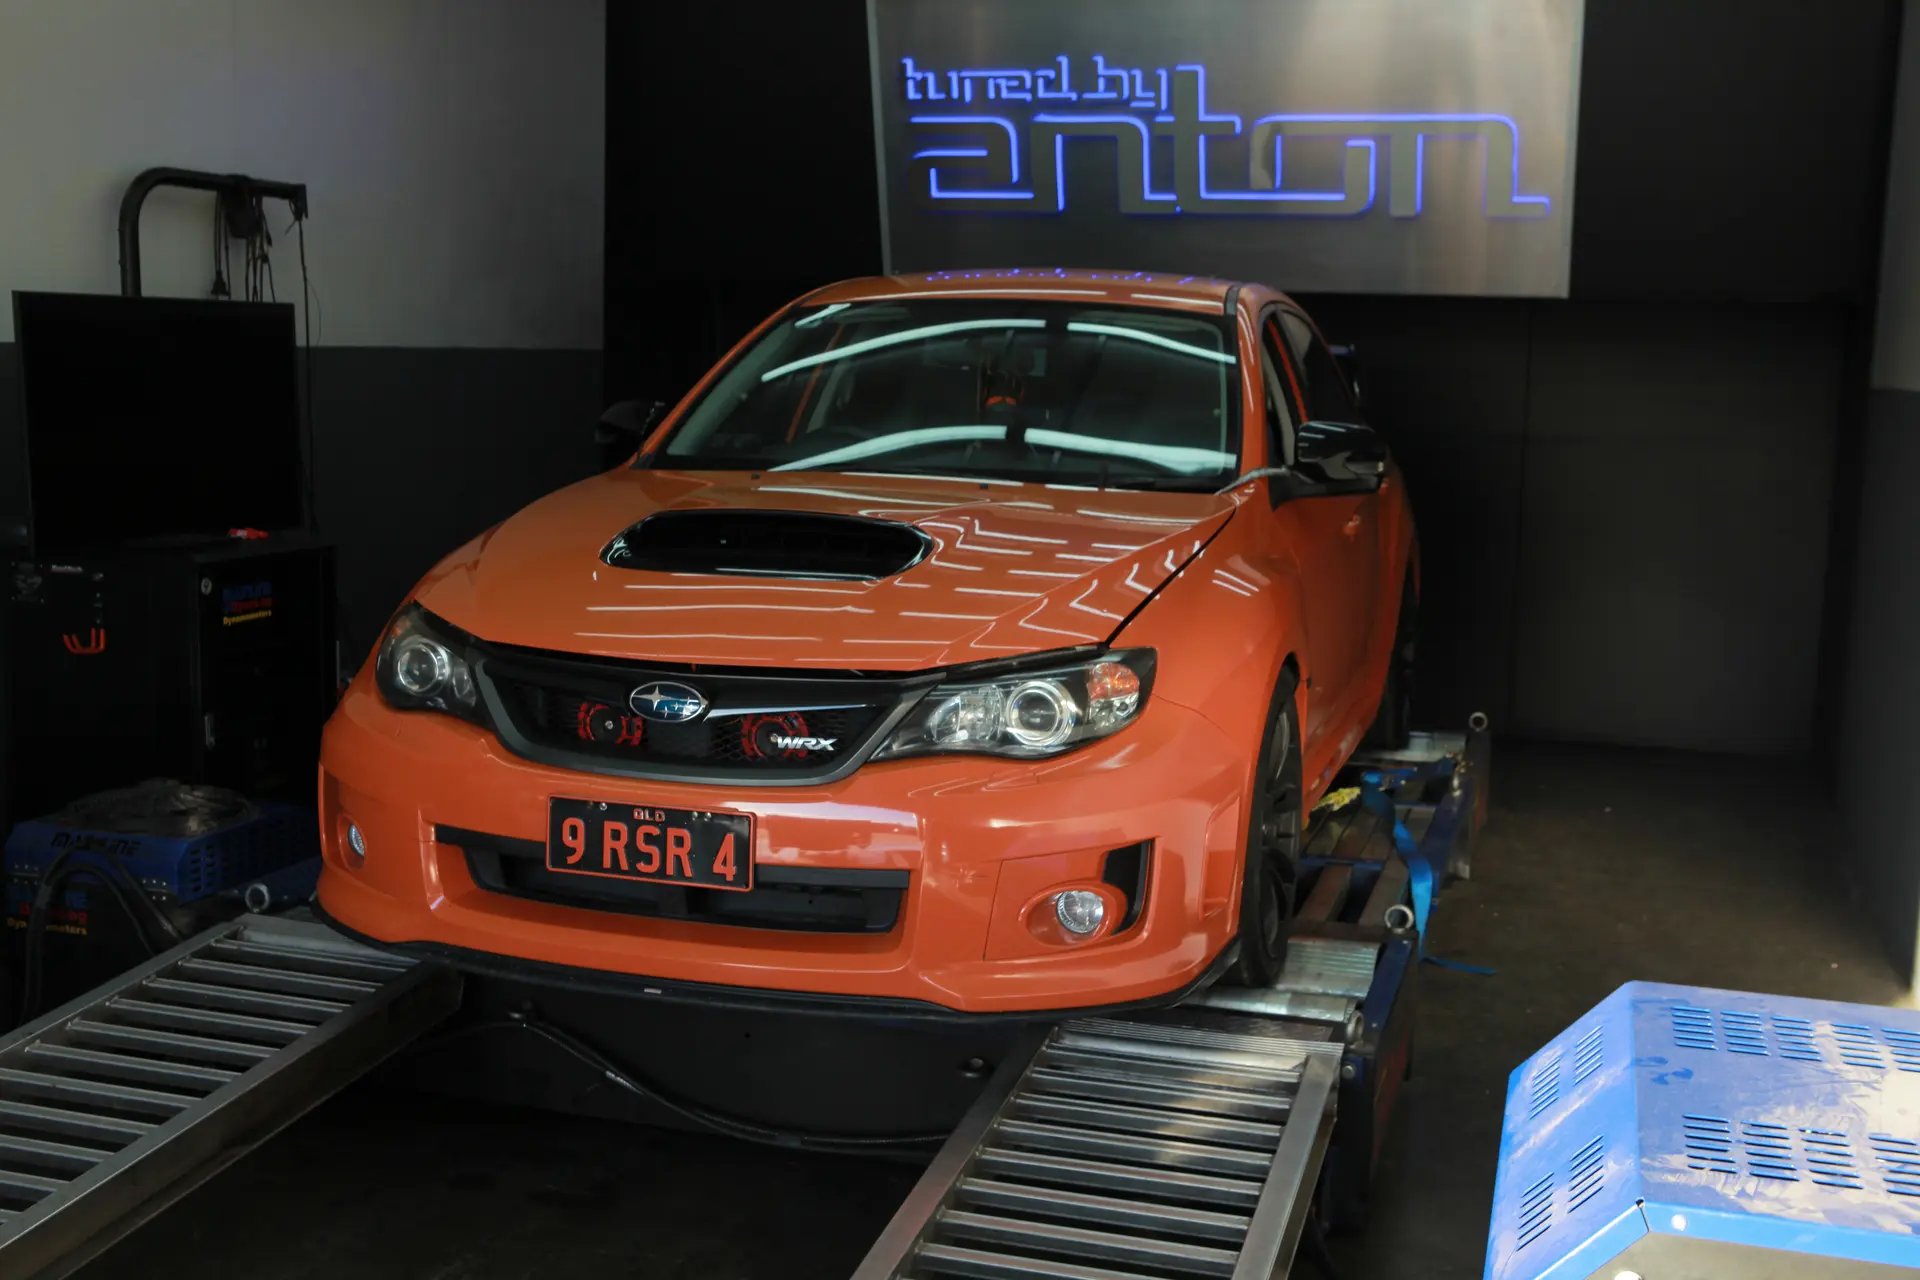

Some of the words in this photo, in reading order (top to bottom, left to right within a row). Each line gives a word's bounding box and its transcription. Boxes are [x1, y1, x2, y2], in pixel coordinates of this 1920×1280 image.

[901, 55, 1078, 103] tuned
[1082, 54, 1170, 111] by
[908, 65, 1552, 218] anton
[776, 735, 838, 751] WRX
[632, 808, 666, 823] QLD
[562, 817, 585, 865] 9
[602, 820, 693, 878] RSR
[712, 832, 737, 882] 4
